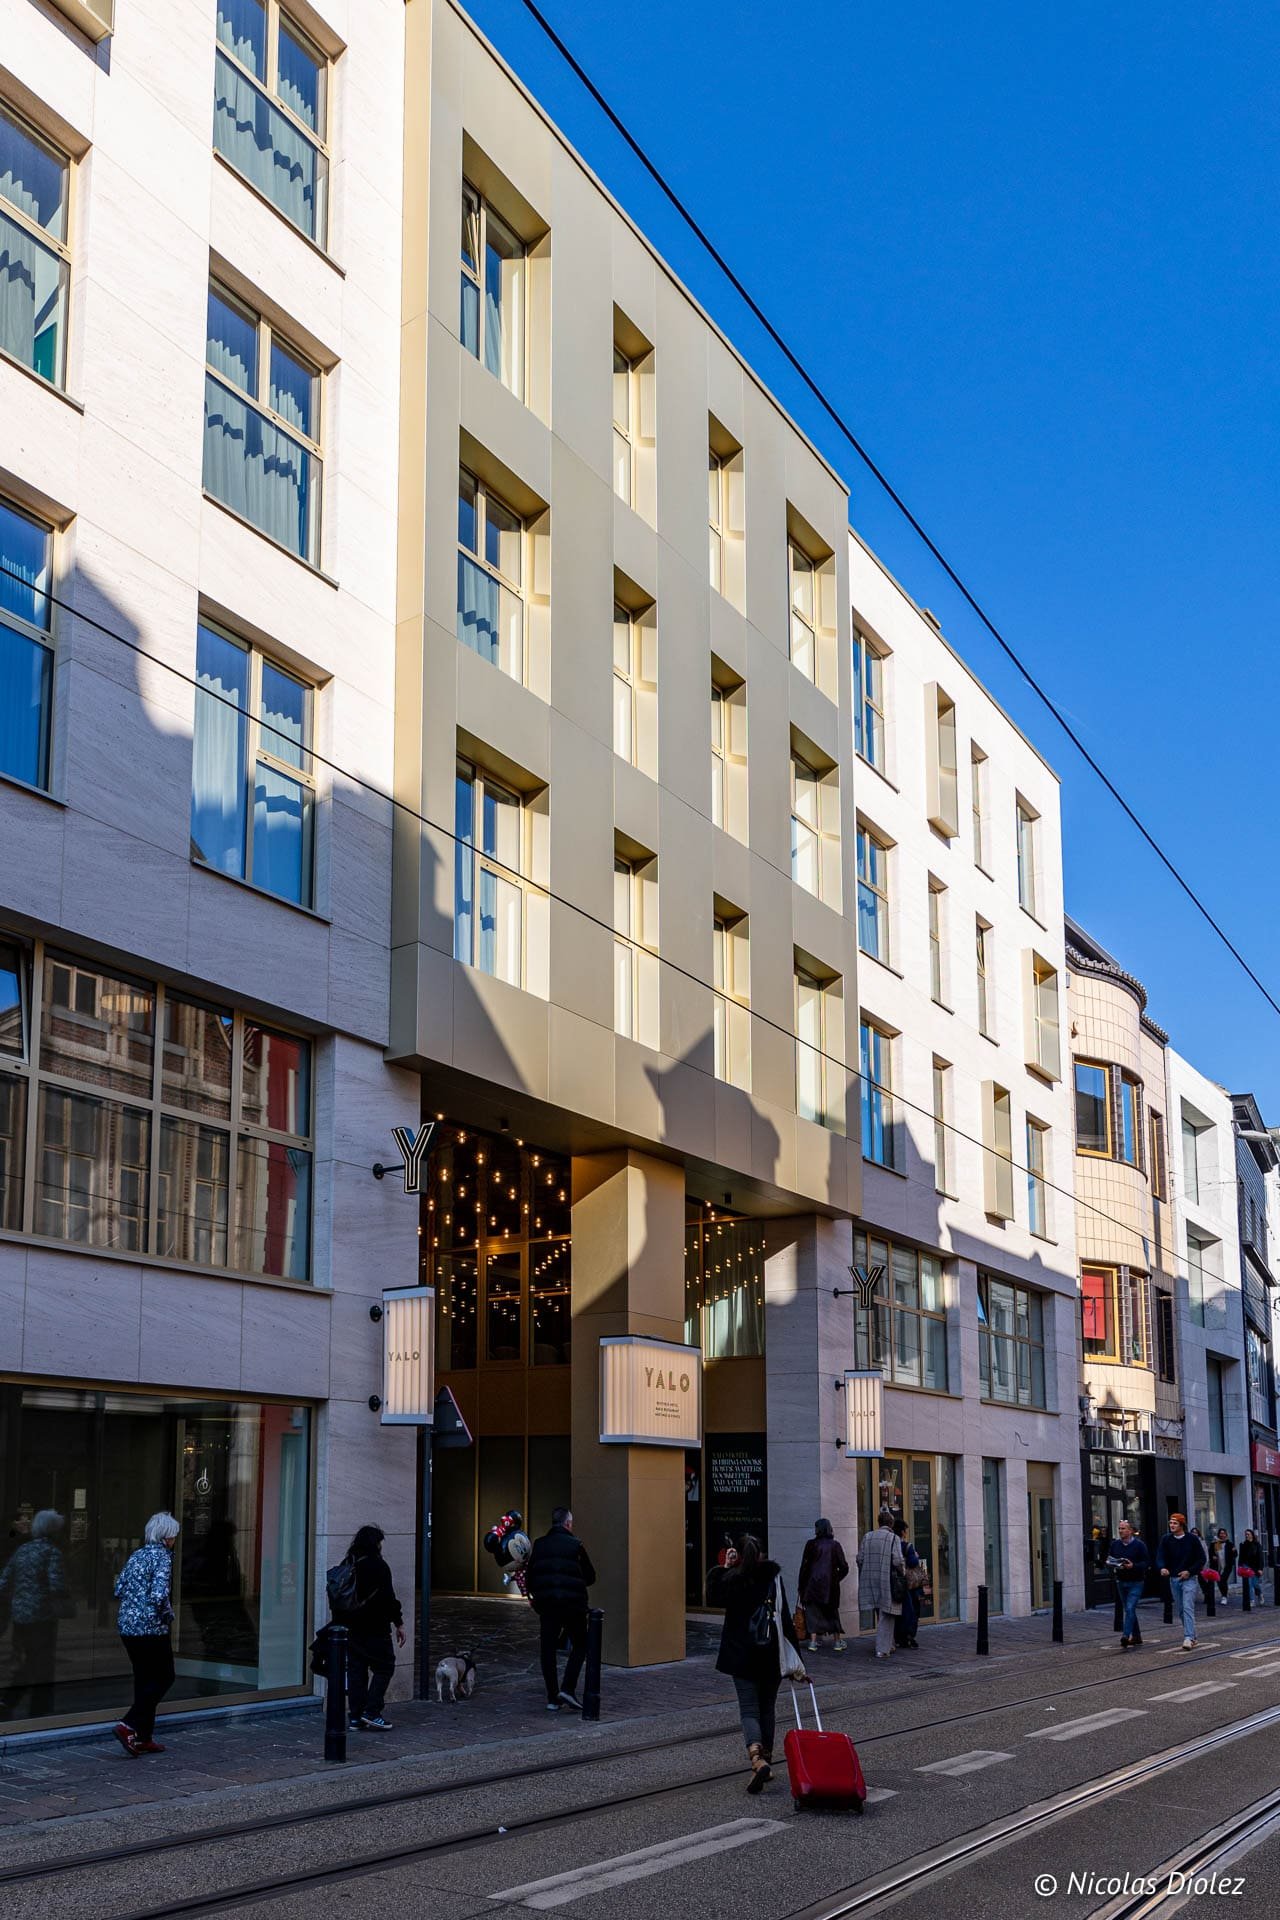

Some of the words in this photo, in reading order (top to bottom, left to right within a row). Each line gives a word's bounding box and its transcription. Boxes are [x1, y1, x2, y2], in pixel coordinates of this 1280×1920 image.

[391, 1122, 435, 1194] Y
[848, 1265, 883, 1310] Y
[388, 1351, 420, 1361] YALO
[645, 1366, 690, 1392] YALO
